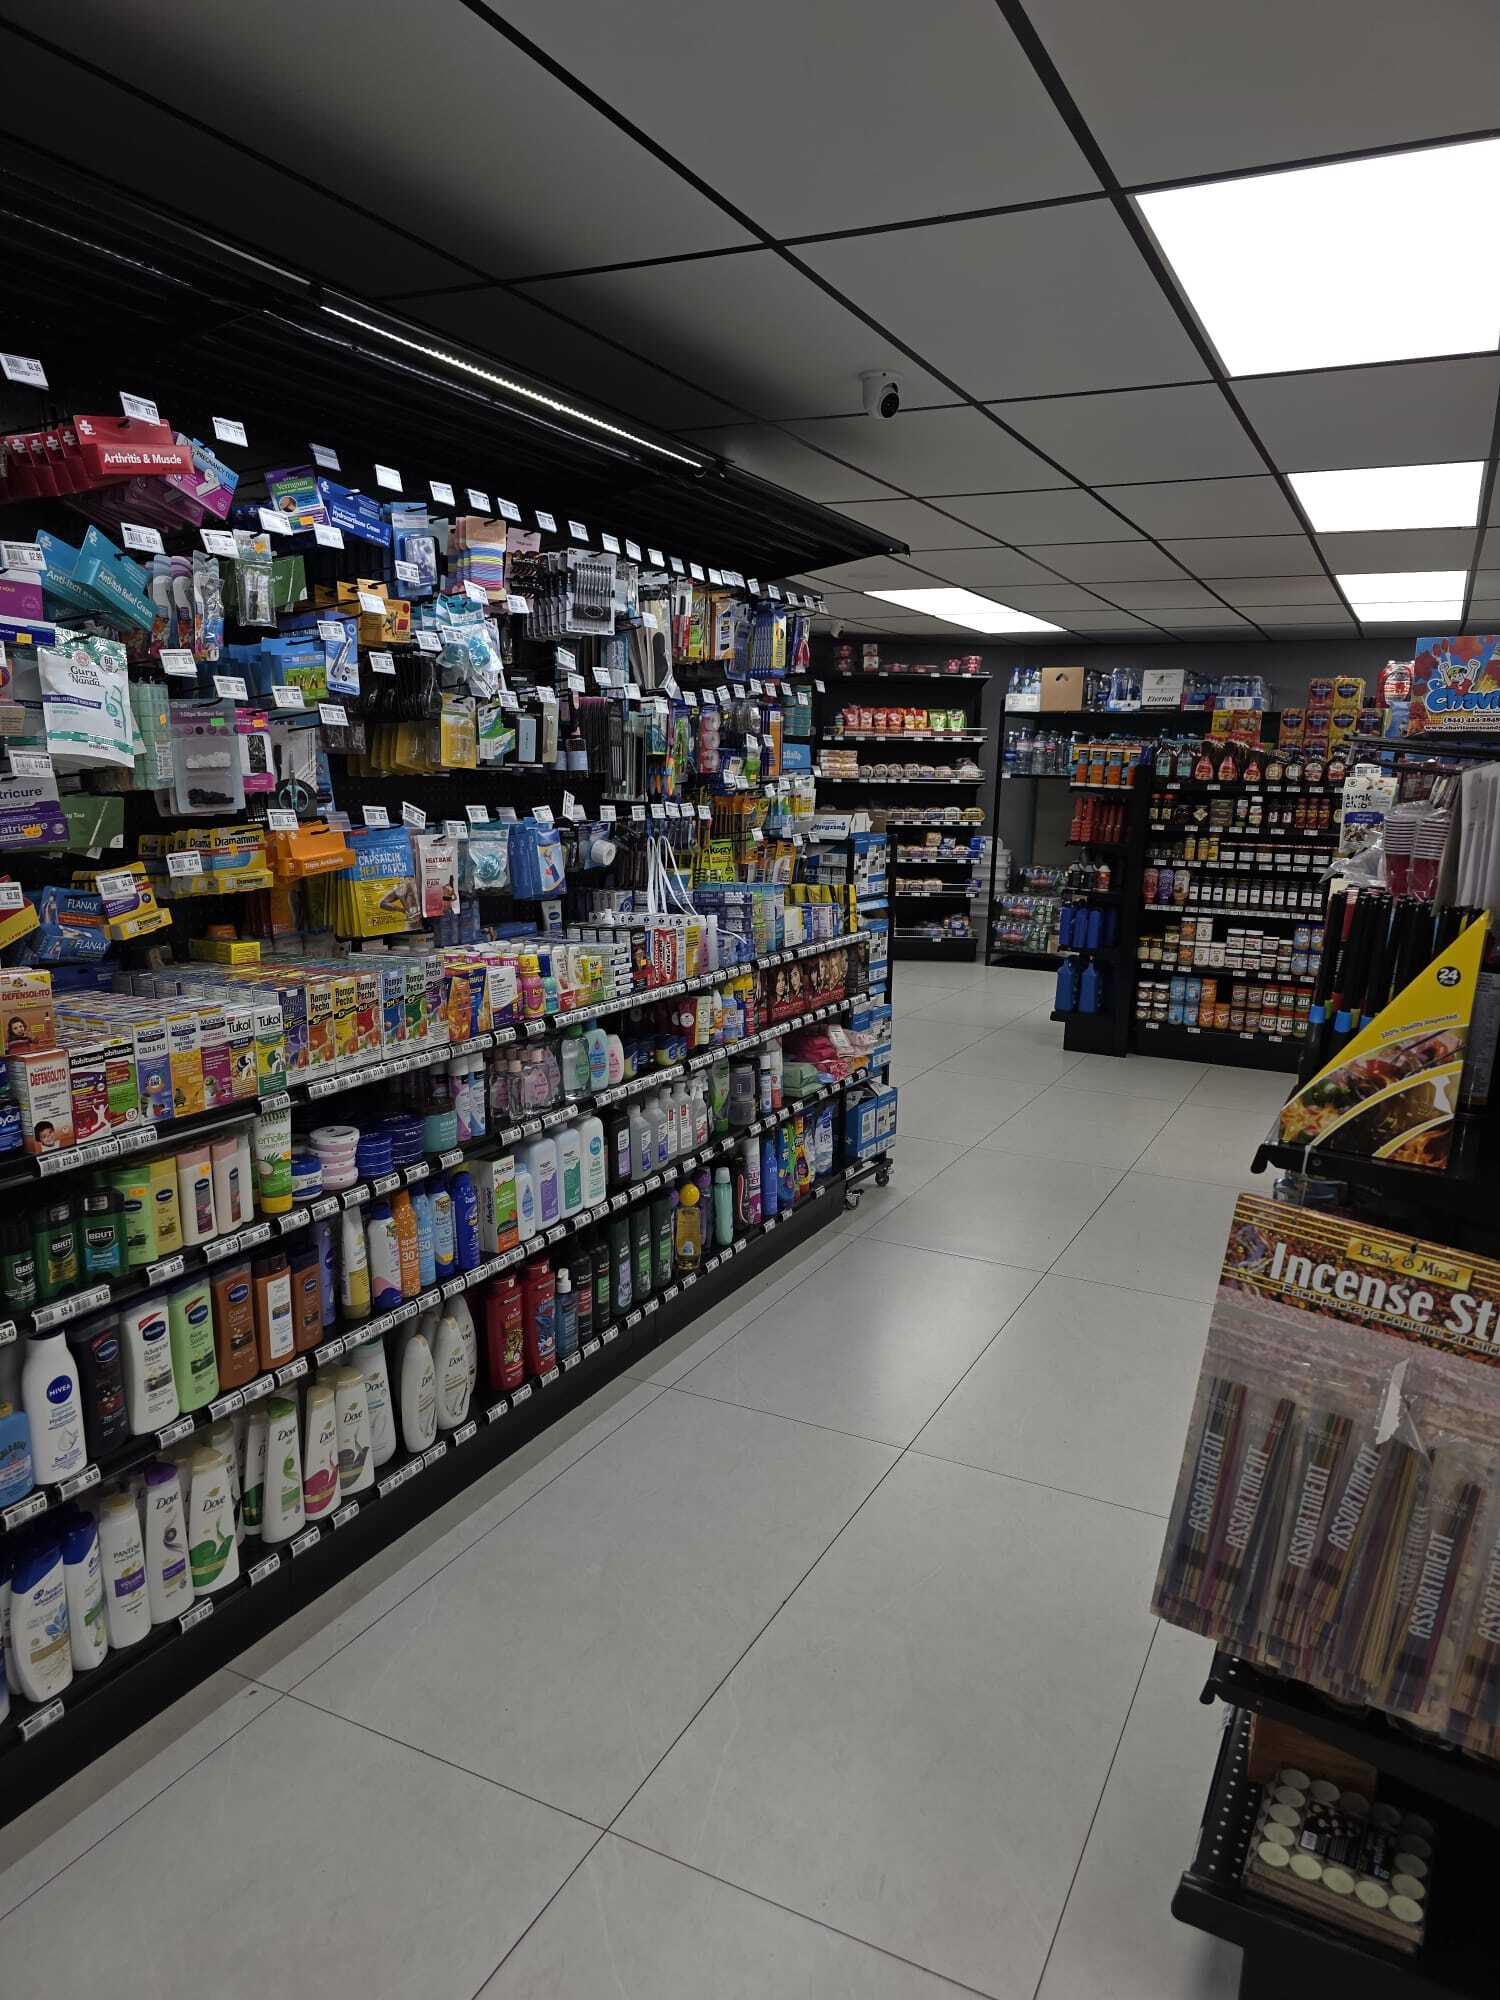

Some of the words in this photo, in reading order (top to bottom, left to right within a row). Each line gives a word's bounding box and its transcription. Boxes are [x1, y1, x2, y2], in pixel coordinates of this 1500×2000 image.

[104, 453, 142, 465] Arthritis
[143, 453, 151, 464] &
[152, 454, 182, 465] Muscle
[47, 569, 82, 594] Anti-Itch
[98, 570, 122, 594] Anti-Itch
[121, 587, 139, 606] Relief
[136, 598, 153, 619] Cream
[70, 665, 98, 678] Guru
[71, 675, 101, 687] Nanda
[1147, 695, 1175, 703] Eternal
[0, 787, 43, 801] tricure
[1, 822, 49, 835] atricure
[189, 838, 211, 849] Drama
[214, 833, 260, 848] Dramamine
[358, 850, 401, 867] CAPSAICIN
[382, 860, 408, 874] PATCH
[67, 898, 99, 910] FLANAX
[75, 939, 108, 951] FLANAX
[405, 973, 425, 984] Rompe
[1438, 967, 1459, 981] 24
[356, 981, 377, 991] Rompe
[406, 981, 423, 992] Pecho
[310, 992, 332, 1003] Rompe
[356, 990, 375, 1000] Pecho
[310, 1002, 331, 1014] Pecho
[228, 1021, 251, 1034] Tukol
[256, 1014, 281, 1028] Tukol
[30, 1068, 67, 1087] DEFENSOLITO
[87, 1229, 113, 1241] BRUT
[51, 1238, 73, 1251] BRUT
[402, 1251, 415, 1262] 30
[1416, 1261, 1459, 1283] Mind
[1269, 1242, 1434, 1323] Incense
[1281, 1284, 1312, 1302] Each
[1316, 1293, 1379, 1321] package
[1382, 1314, 1448, 1338] contains
[49, 1383, 72, 1397] NIVEA
[365, 1379, 385, 1393] Dove
[343, 1410, 363, 1424] Dove
[278, 1425, 297, 1441] Dove
[319, 1428, 336, 1444] Dove
[1187, 1429, 1226, 1535] ASSORTMENT
[156, 1491, 178, 1510] Dove
[202, 1495, 225, 1512] Dove
[1224, 1443, 1271, 1552] ASSORTMENT
[1326, 1441, 1384, 1553] ASSORTMENT
[1287, 1461, 1331, 1570] ASSORTMENT
[1407, 1528, 1456, 1641] ASSORTMENT
